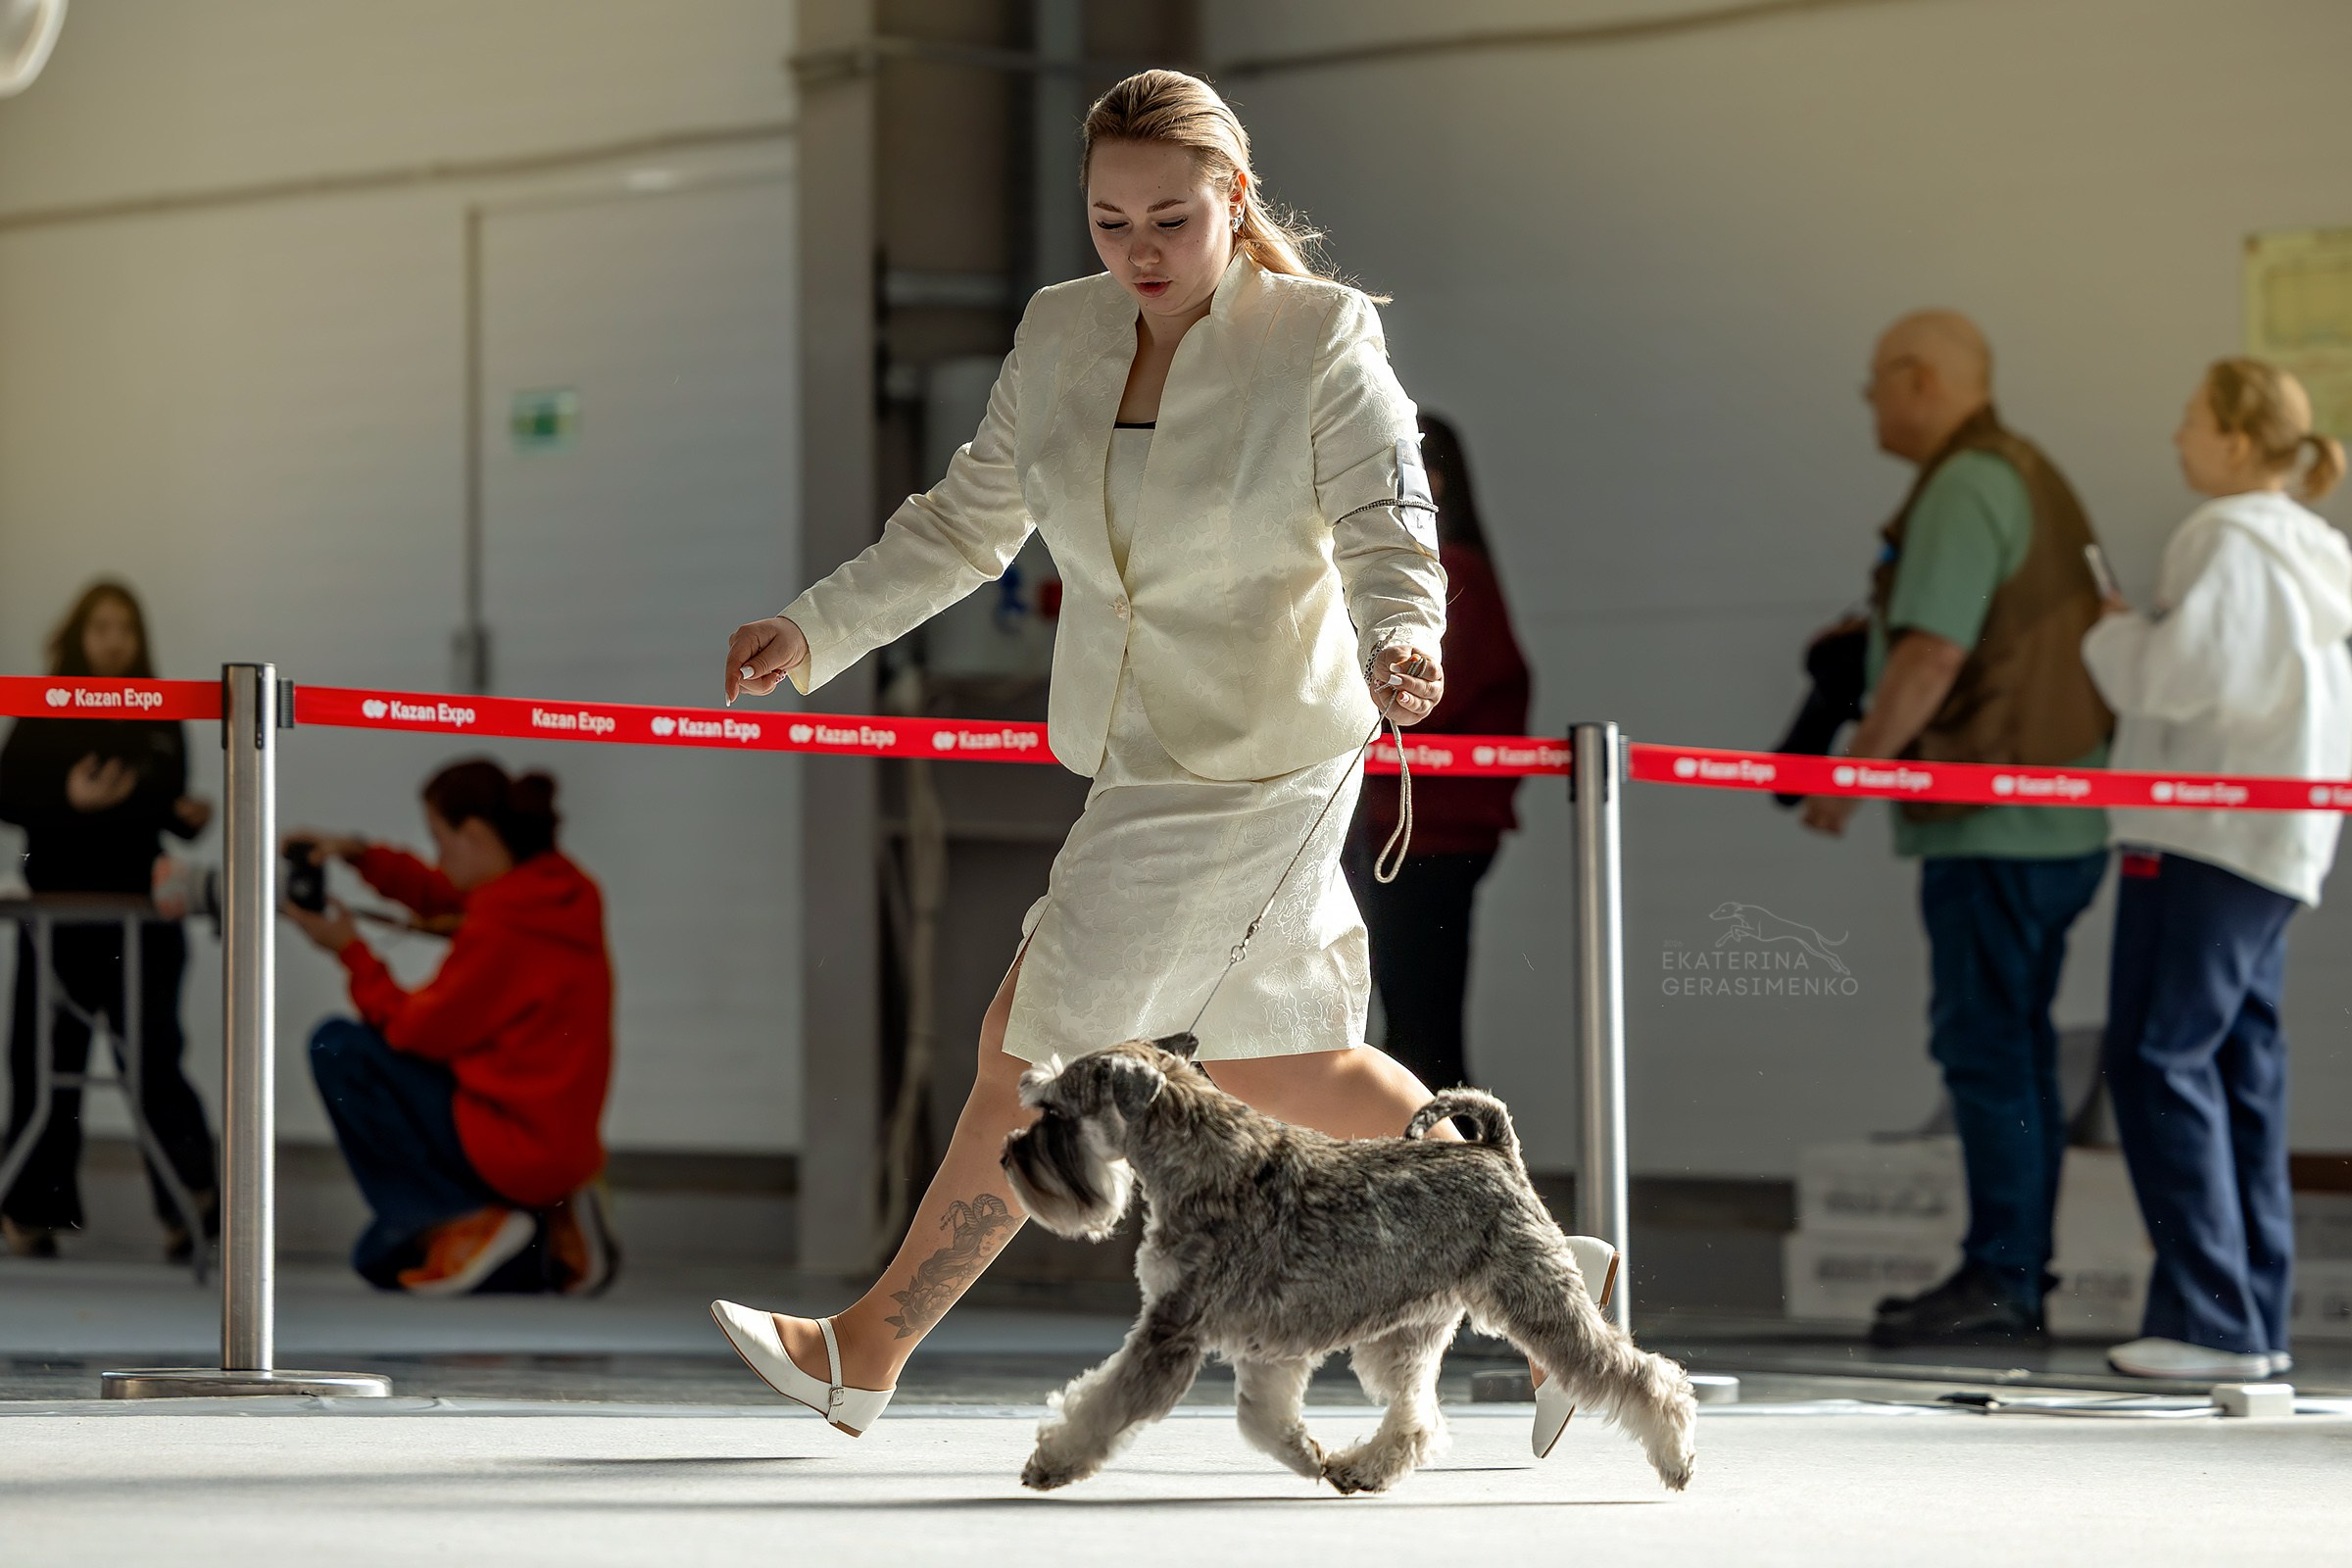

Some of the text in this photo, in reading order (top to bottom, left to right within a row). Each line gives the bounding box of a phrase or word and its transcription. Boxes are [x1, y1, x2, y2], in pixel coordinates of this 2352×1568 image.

[74, 688, 164, 711] Kazan Expo
[390, 700, 476, 728] Kazan Expo
[531, 708, 615, 735] Kazan Expo
[678, 716, 761, 743] Kazan Expo
[814, 724, 897, 750] Kazan Expo
[957, 729, 1039, 752] Kazan Expo
